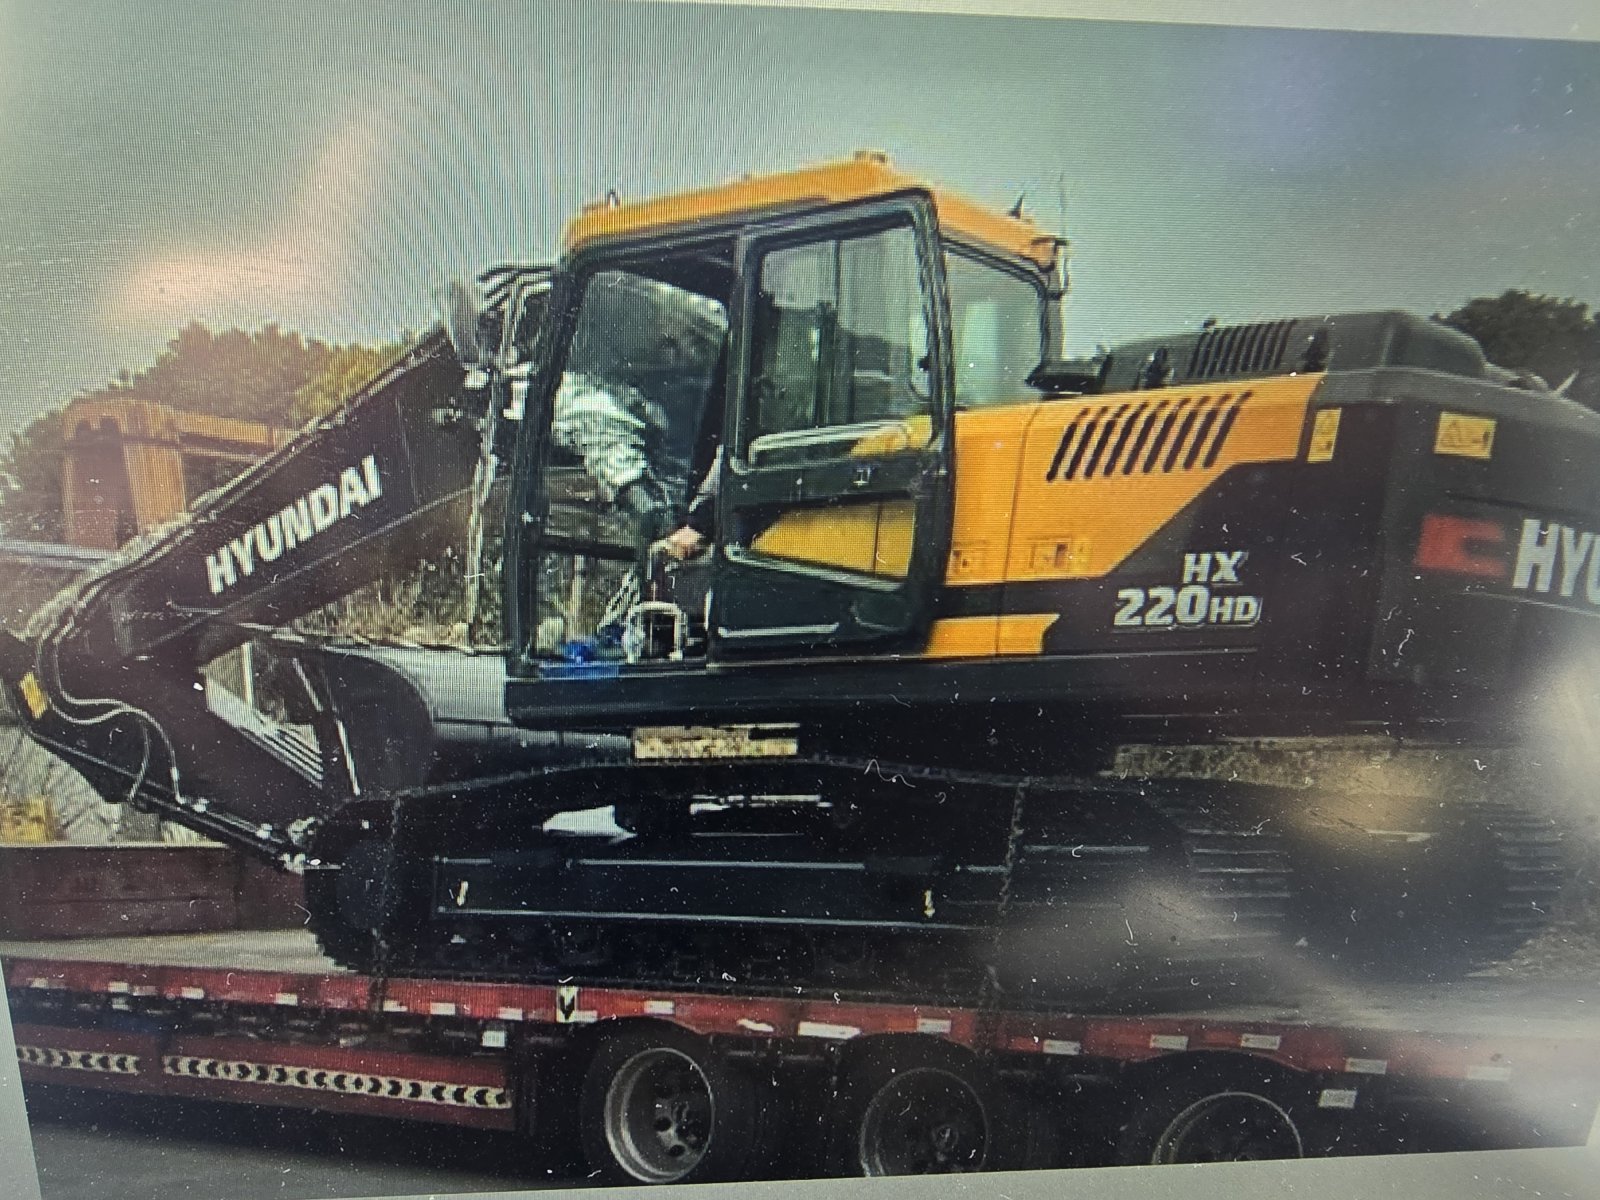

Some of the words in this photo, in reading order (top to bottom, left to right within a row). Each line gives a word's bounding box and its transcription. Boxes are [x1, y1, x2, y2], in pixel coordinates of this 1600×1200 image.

[205, 454, 383, 595] HYUNDAI
[1182, 551, 1244, 584] HX
[1113, 585, 1260, 627] 220HD
